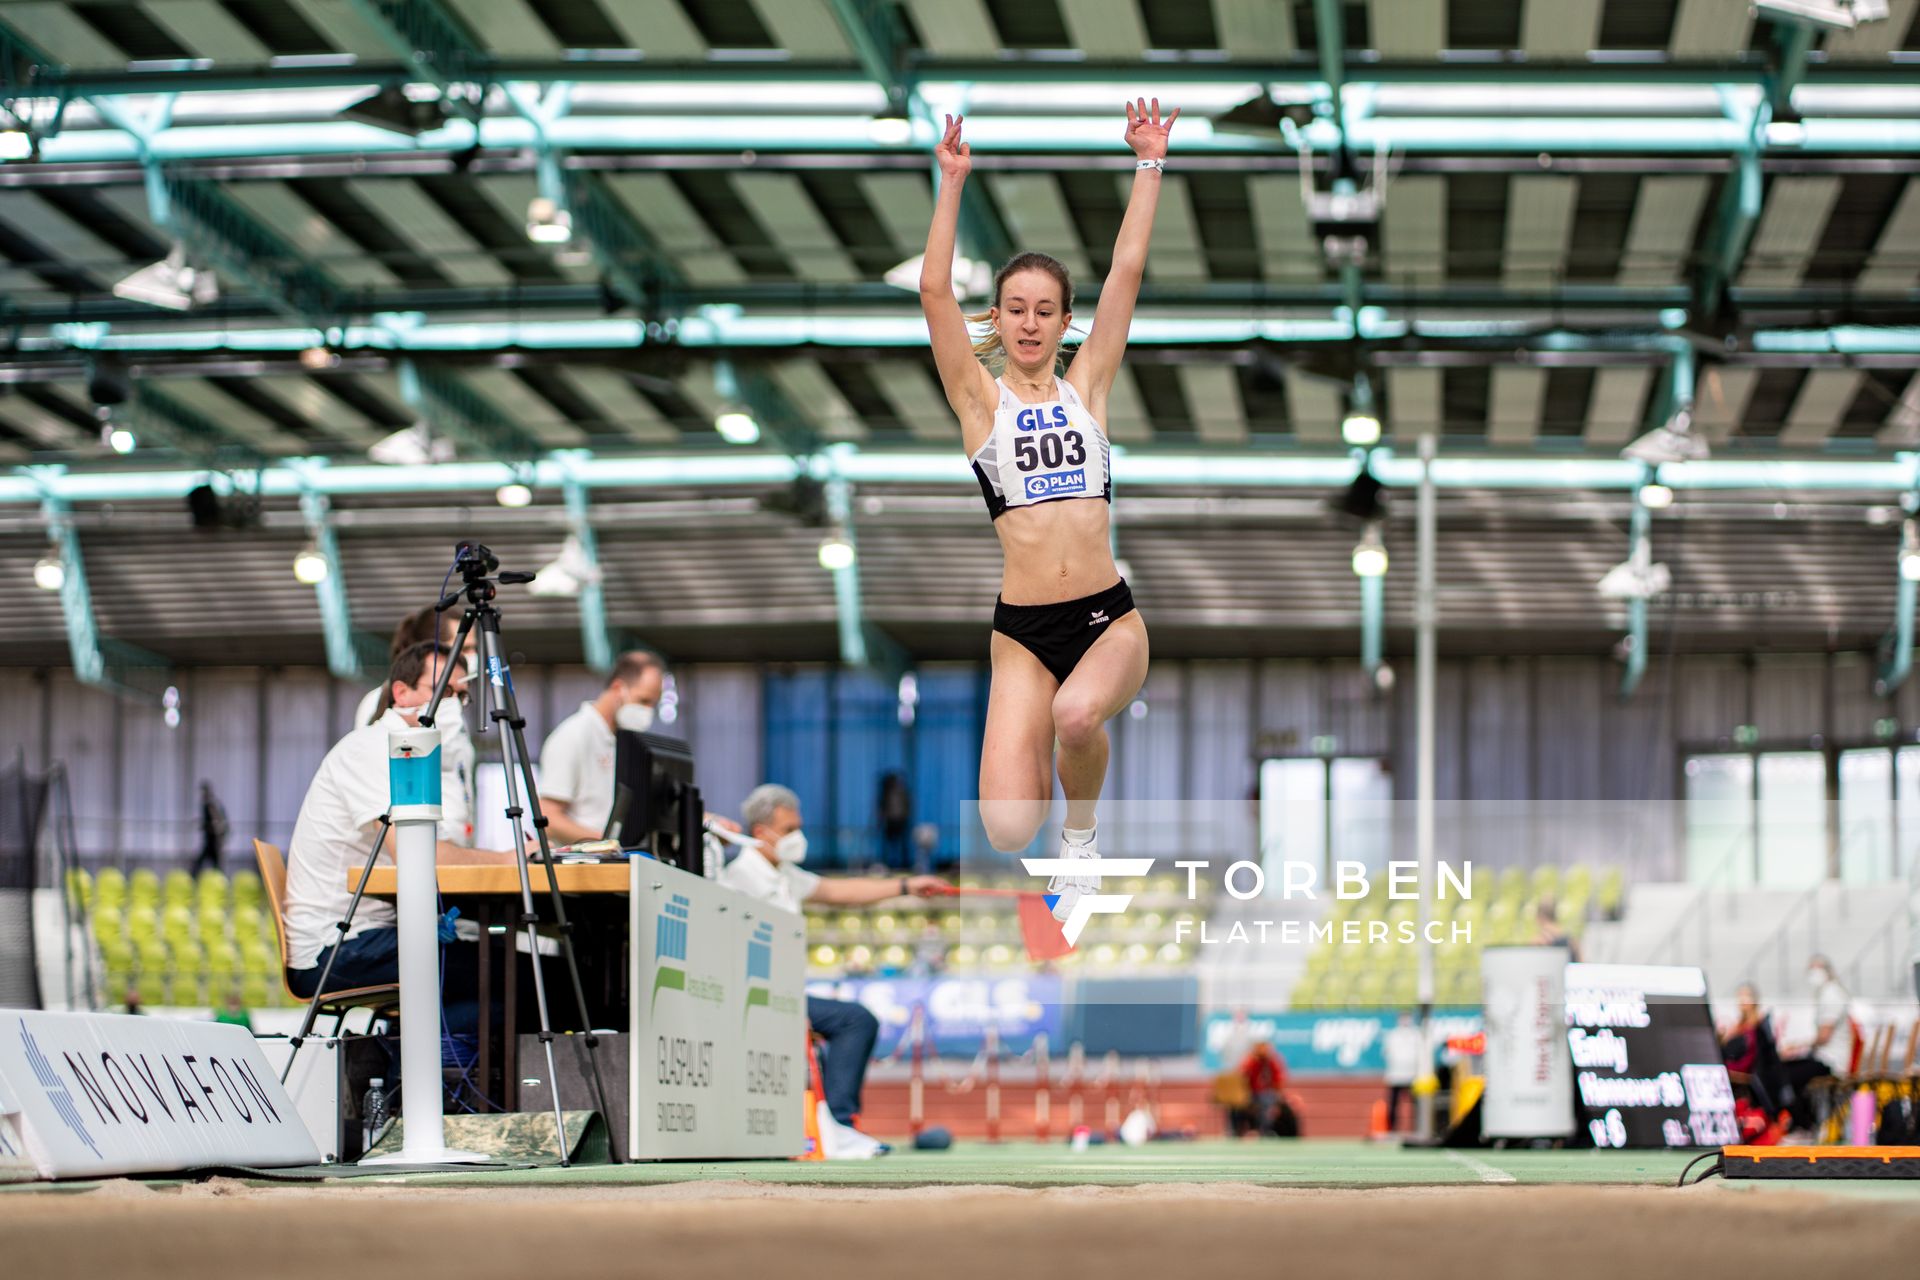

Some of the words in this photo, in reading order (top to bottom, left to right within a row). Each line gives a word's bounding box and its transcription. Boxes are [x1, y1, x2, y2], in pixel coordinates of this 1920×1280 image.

[1017, 406, 1068, 431] GLS
[1014, 430, 1087, 472] 503
[1050, 474, 1083, 487] PLAN
[1089, 615, 1110, 626] erima
[63, 1051, 282, 1124] NOVAFON
